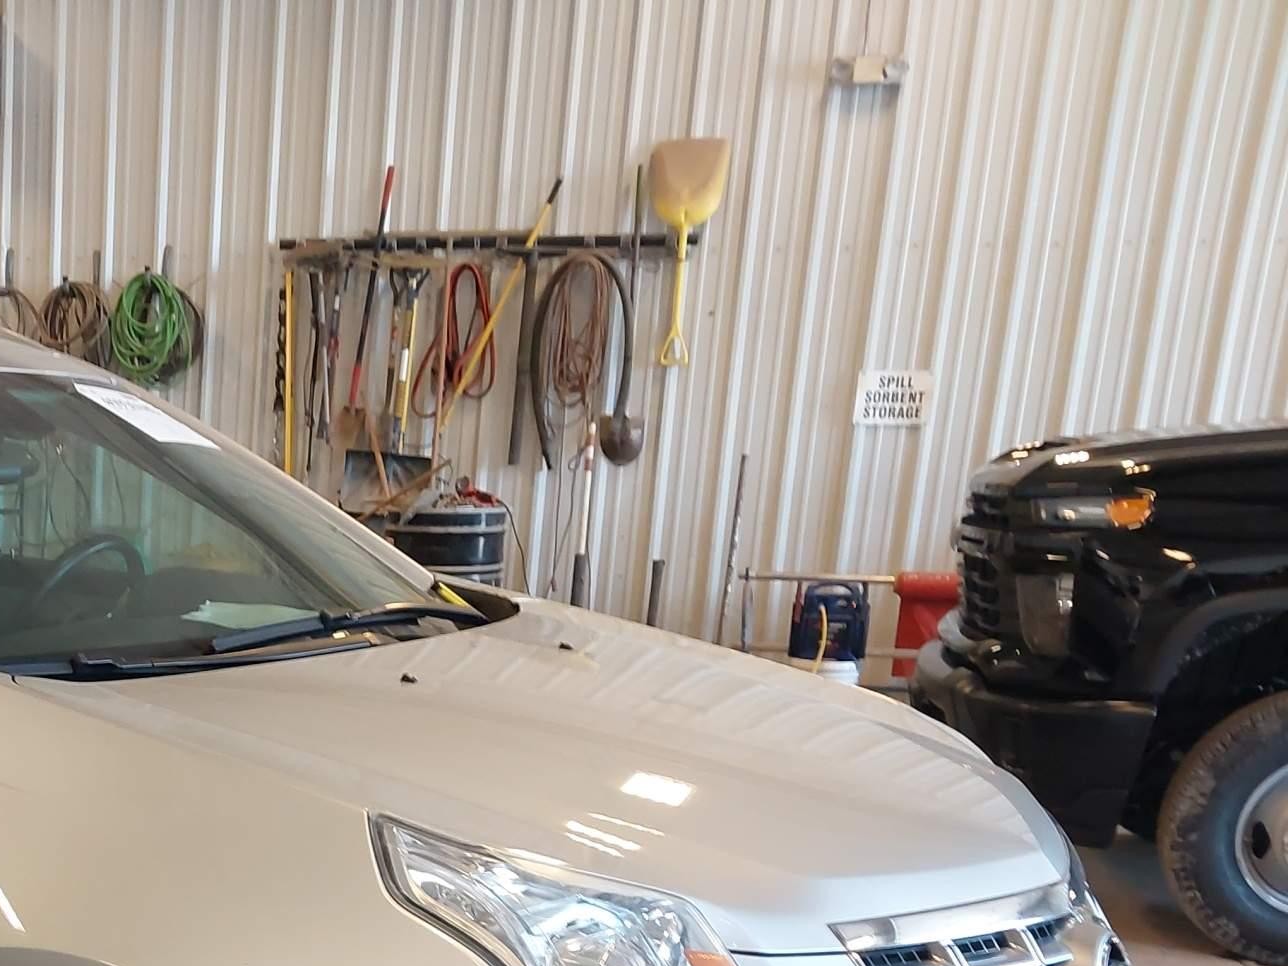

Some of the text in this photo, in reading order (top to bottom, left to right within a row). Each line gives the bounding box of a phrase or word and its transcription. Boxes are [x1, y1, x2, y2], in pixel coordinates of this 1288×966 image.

[878, 375, 913, 389] SPILL
[864, 390, 925, 404] SORBENT
[863, 405, 921, 419] STORAGE
